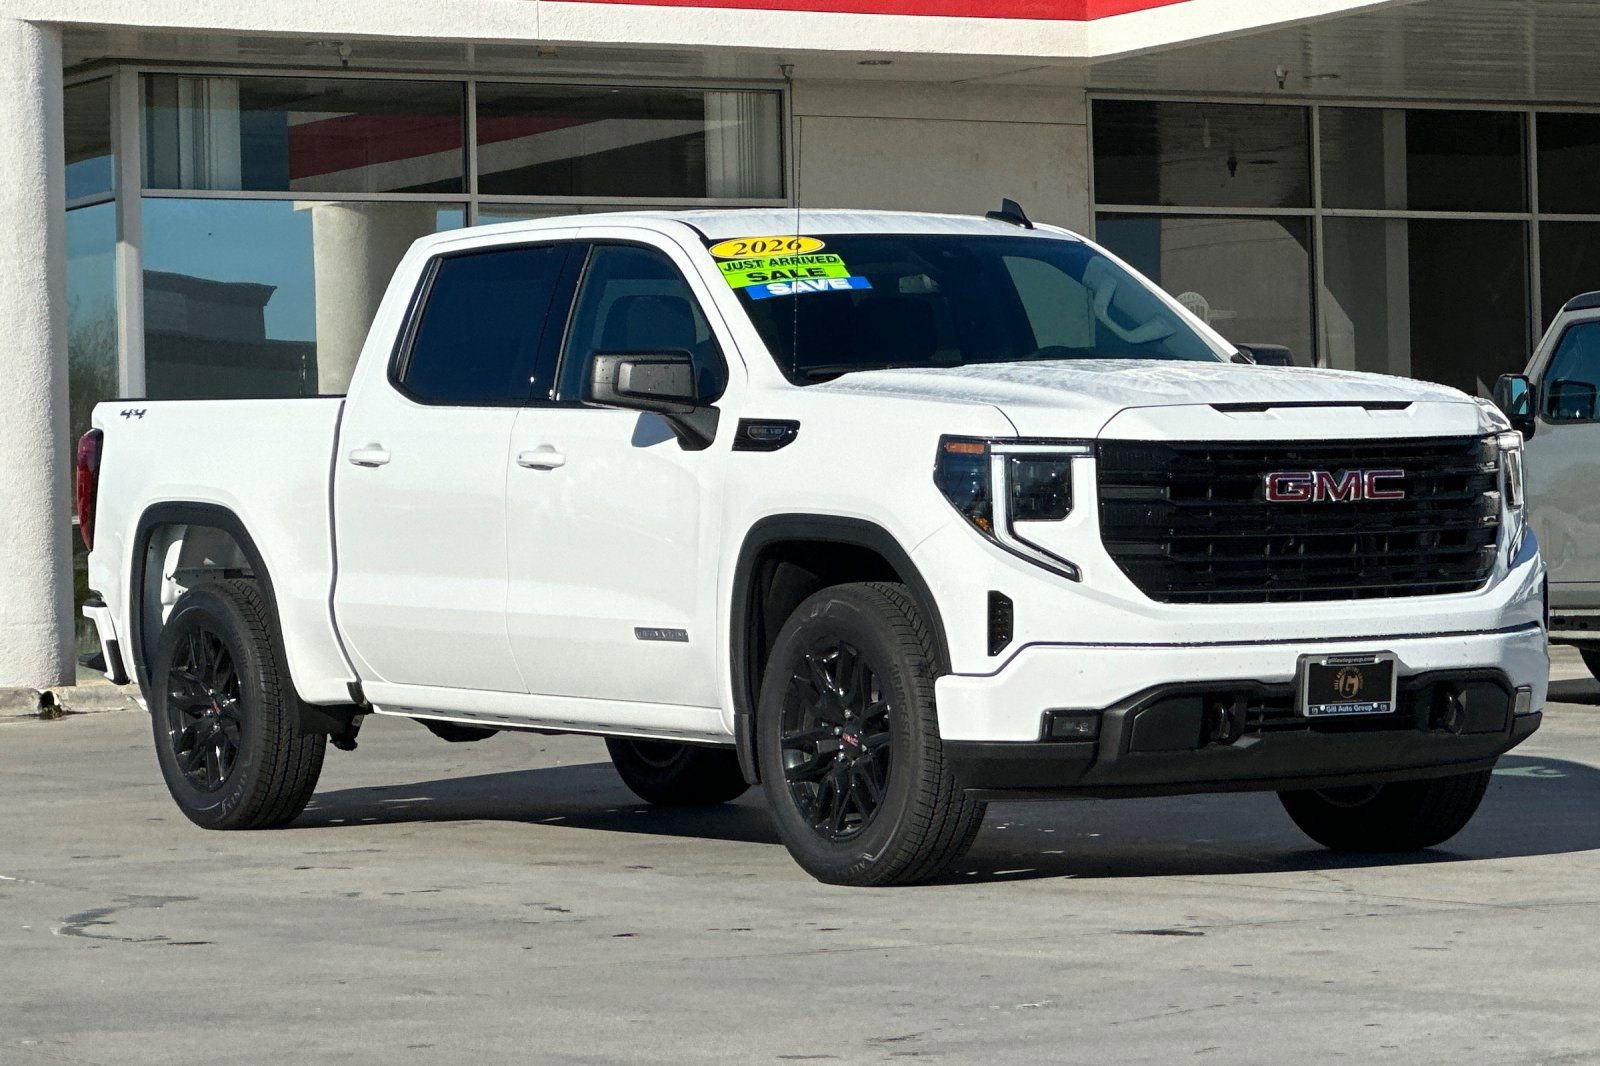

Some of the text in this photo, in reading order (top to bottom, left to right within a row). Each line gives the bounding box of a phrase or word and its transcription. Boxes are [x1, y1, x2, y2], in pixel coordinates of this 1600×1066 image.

[733, 239, 803, 256] 2026
[724, 255, 838, 272] JUST ARRIVED
[746, 268, 826, 283] SALE
[765, 278, 853, 296] SAVE
[1265, 469, 1405, 502] GMC
